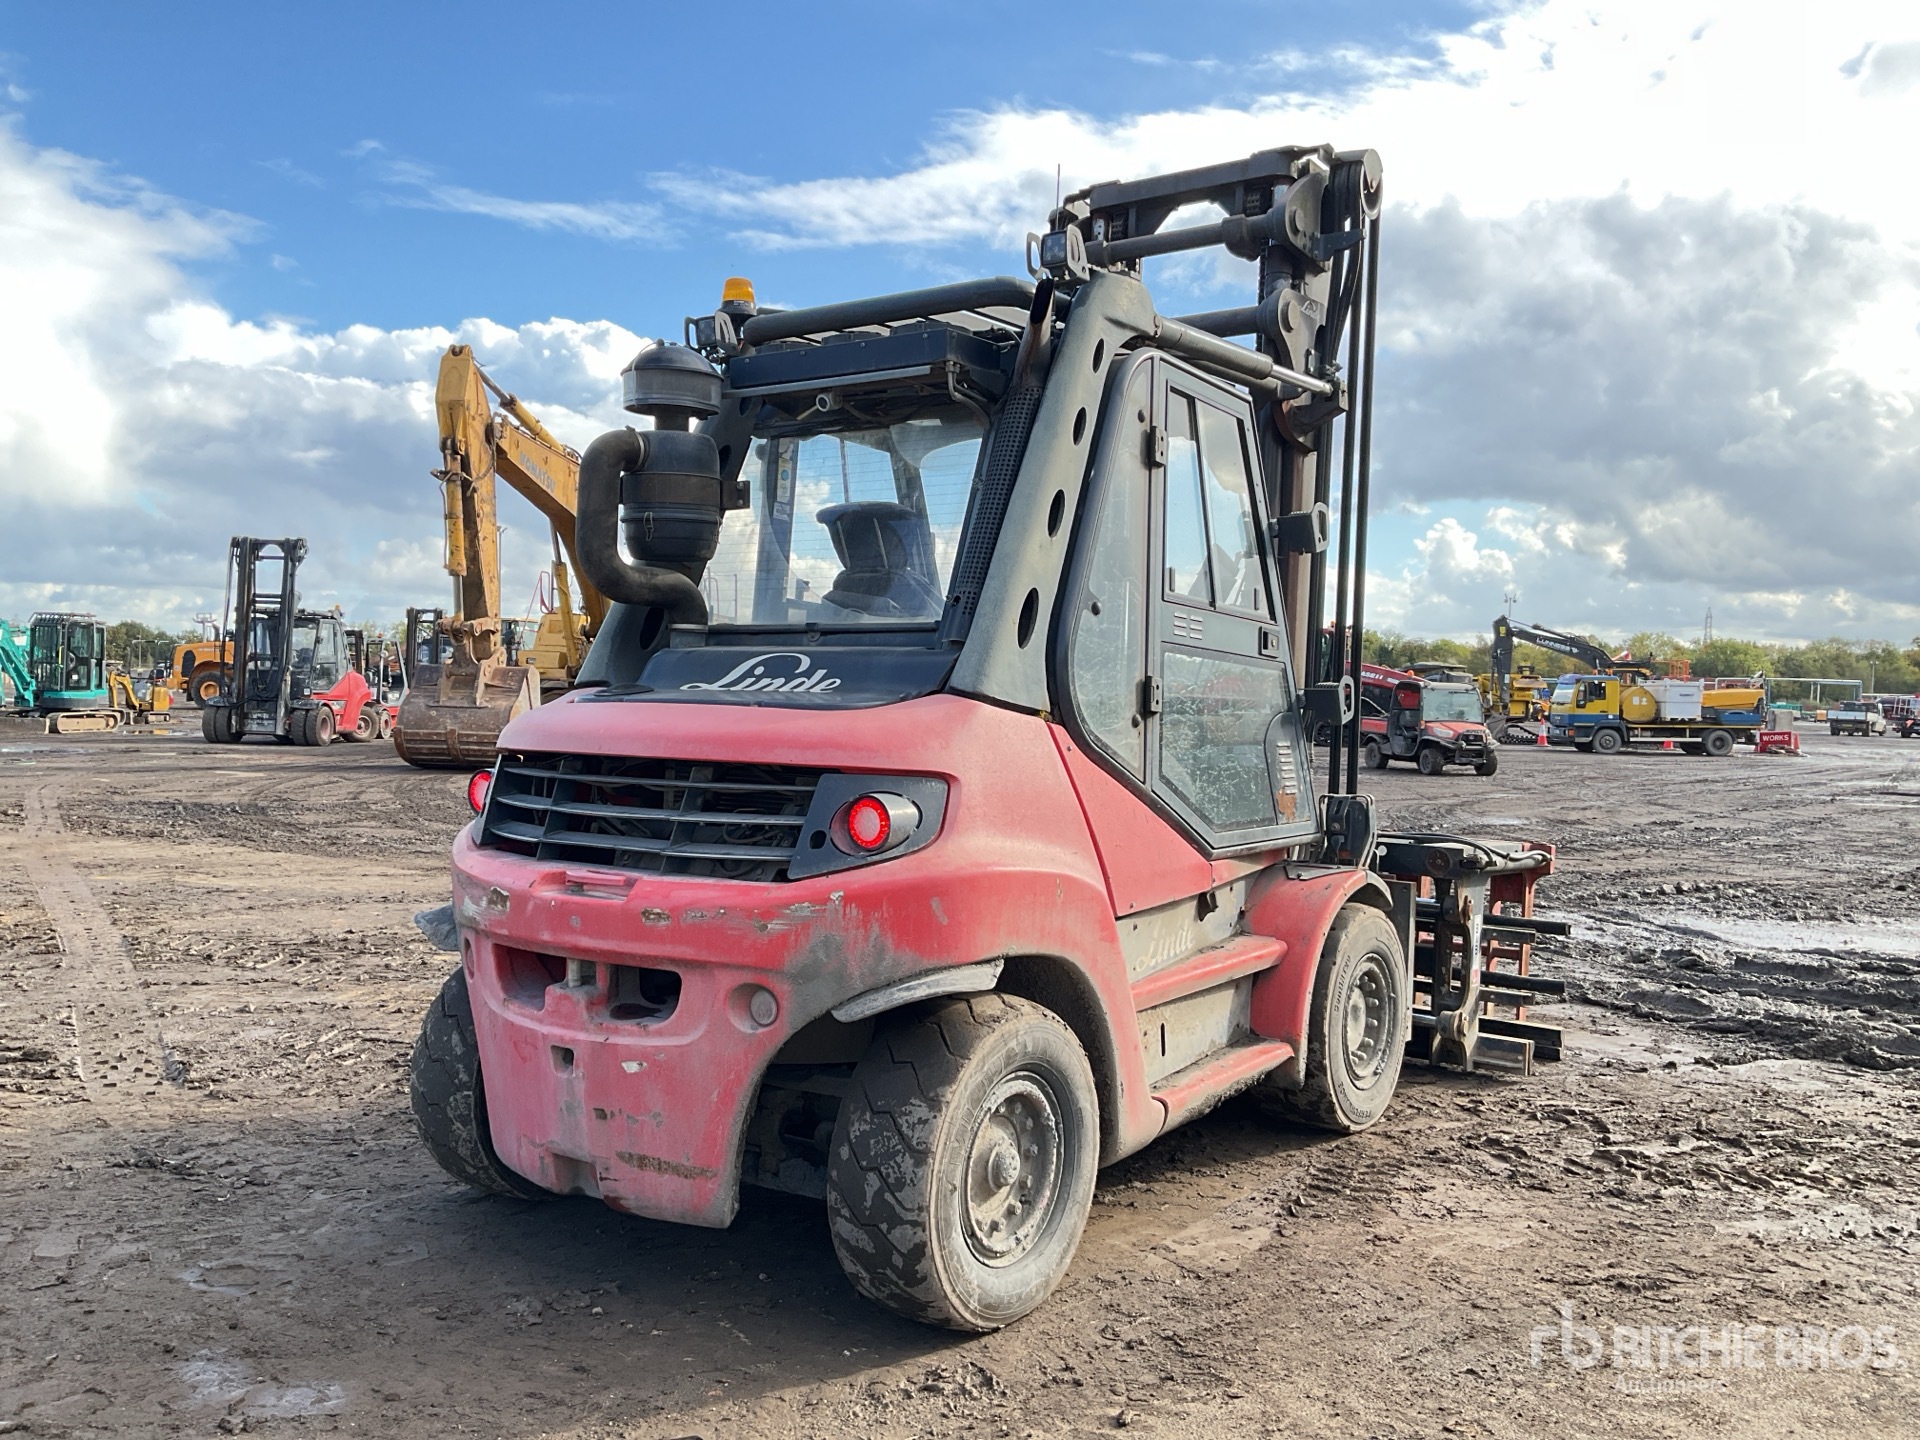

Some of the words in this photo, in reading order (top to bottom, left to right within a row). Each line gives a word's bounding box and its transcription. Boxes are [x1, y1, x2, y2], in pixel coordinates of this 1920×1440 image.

[519, 451, 555, 493] KOMATSU
[679, 652, 841, 693] Linde
[1762, 734, 1789, 742] WORKS
[1136, 919, 1196, 972] Linde
